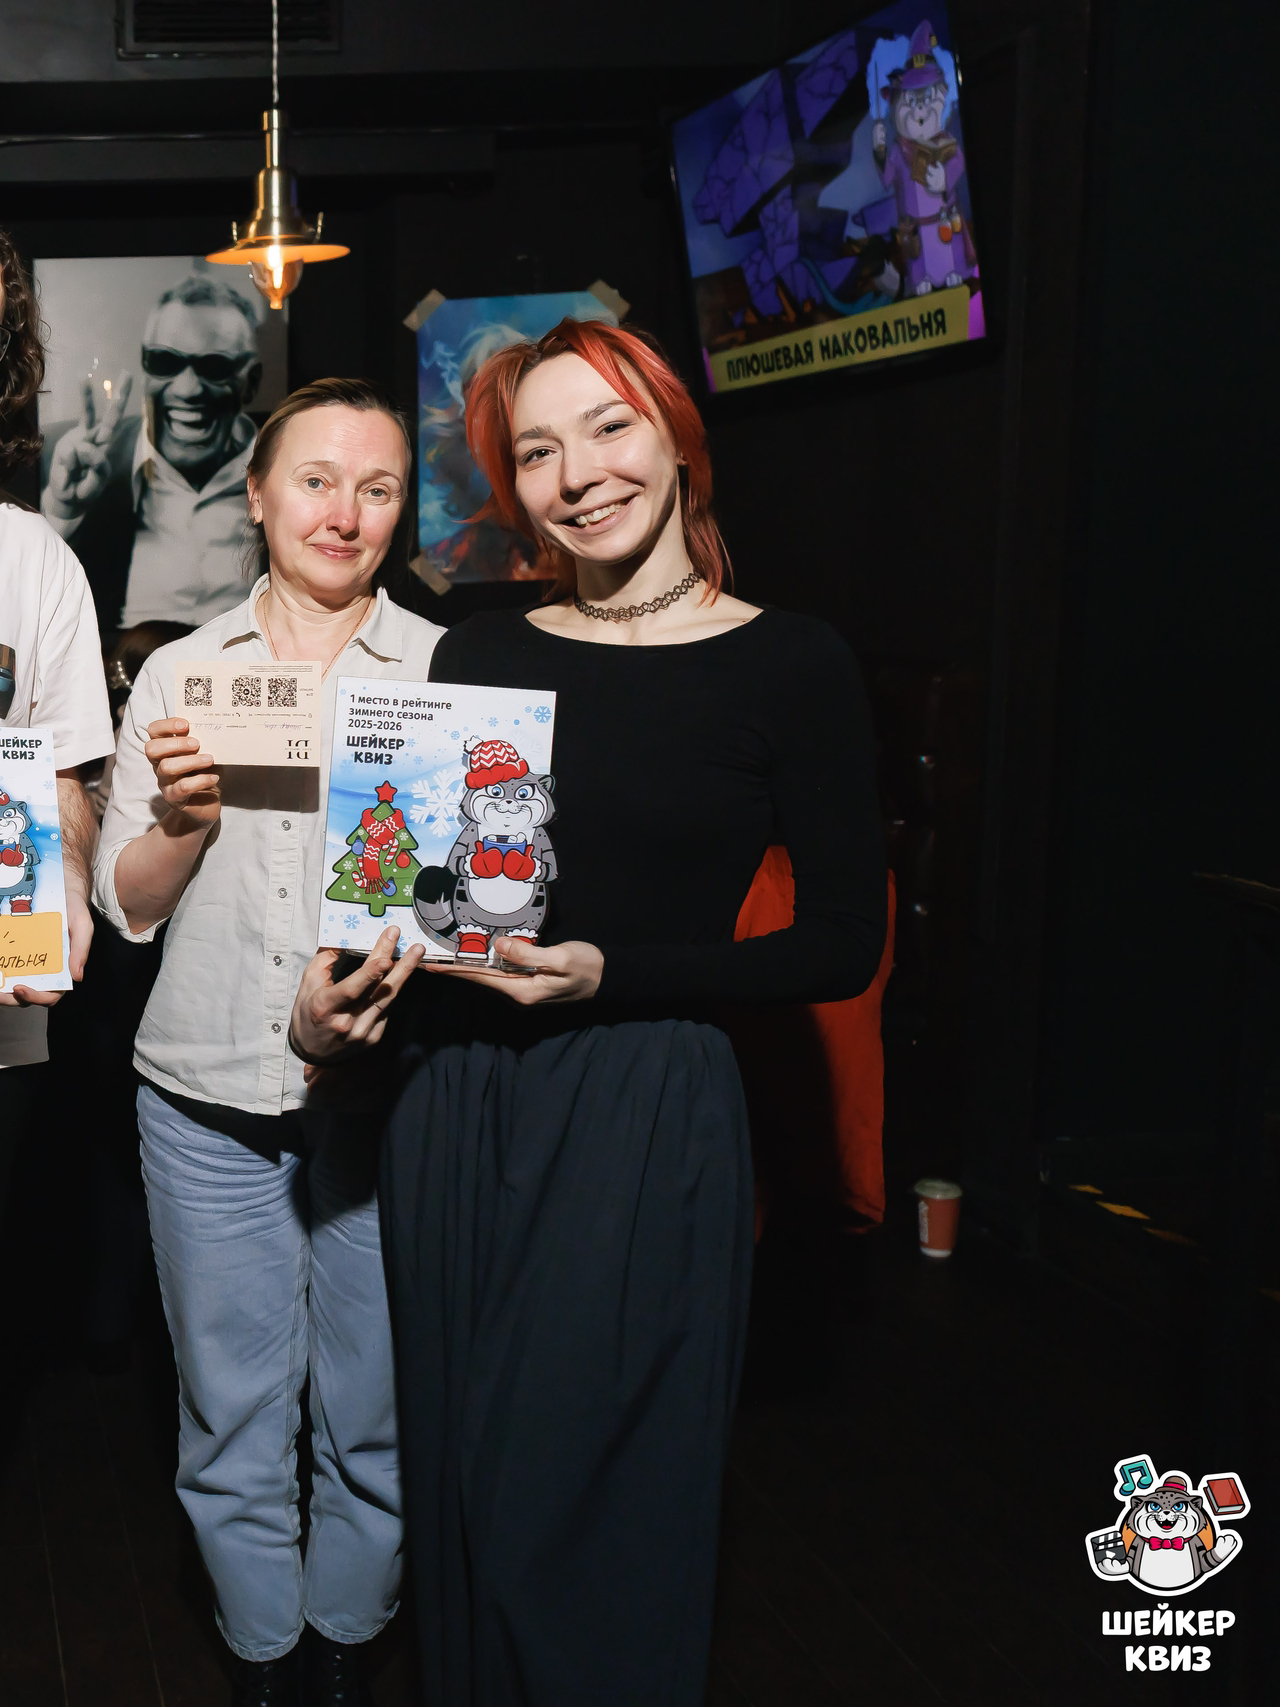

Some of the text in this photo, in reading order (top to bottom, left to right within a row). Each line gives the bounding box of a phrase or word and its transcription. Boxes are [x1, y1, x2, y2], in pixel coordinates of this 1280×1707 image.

[726, 308, 947, 382] ПЛЮШЕВАЯ НАКОВАЛЬНЯ
[350, 694, 452, 710] 1 место в рейтинге
[348, 707, 434, 721] зимнего сезона
[347, 718, 403, 731] 2025-2026
[346, 733, 405, 750] ШЕЙКЕР
[2, 749, 35, 760] КВИЗ
[354, 751, 393, 766] КВИЗ
